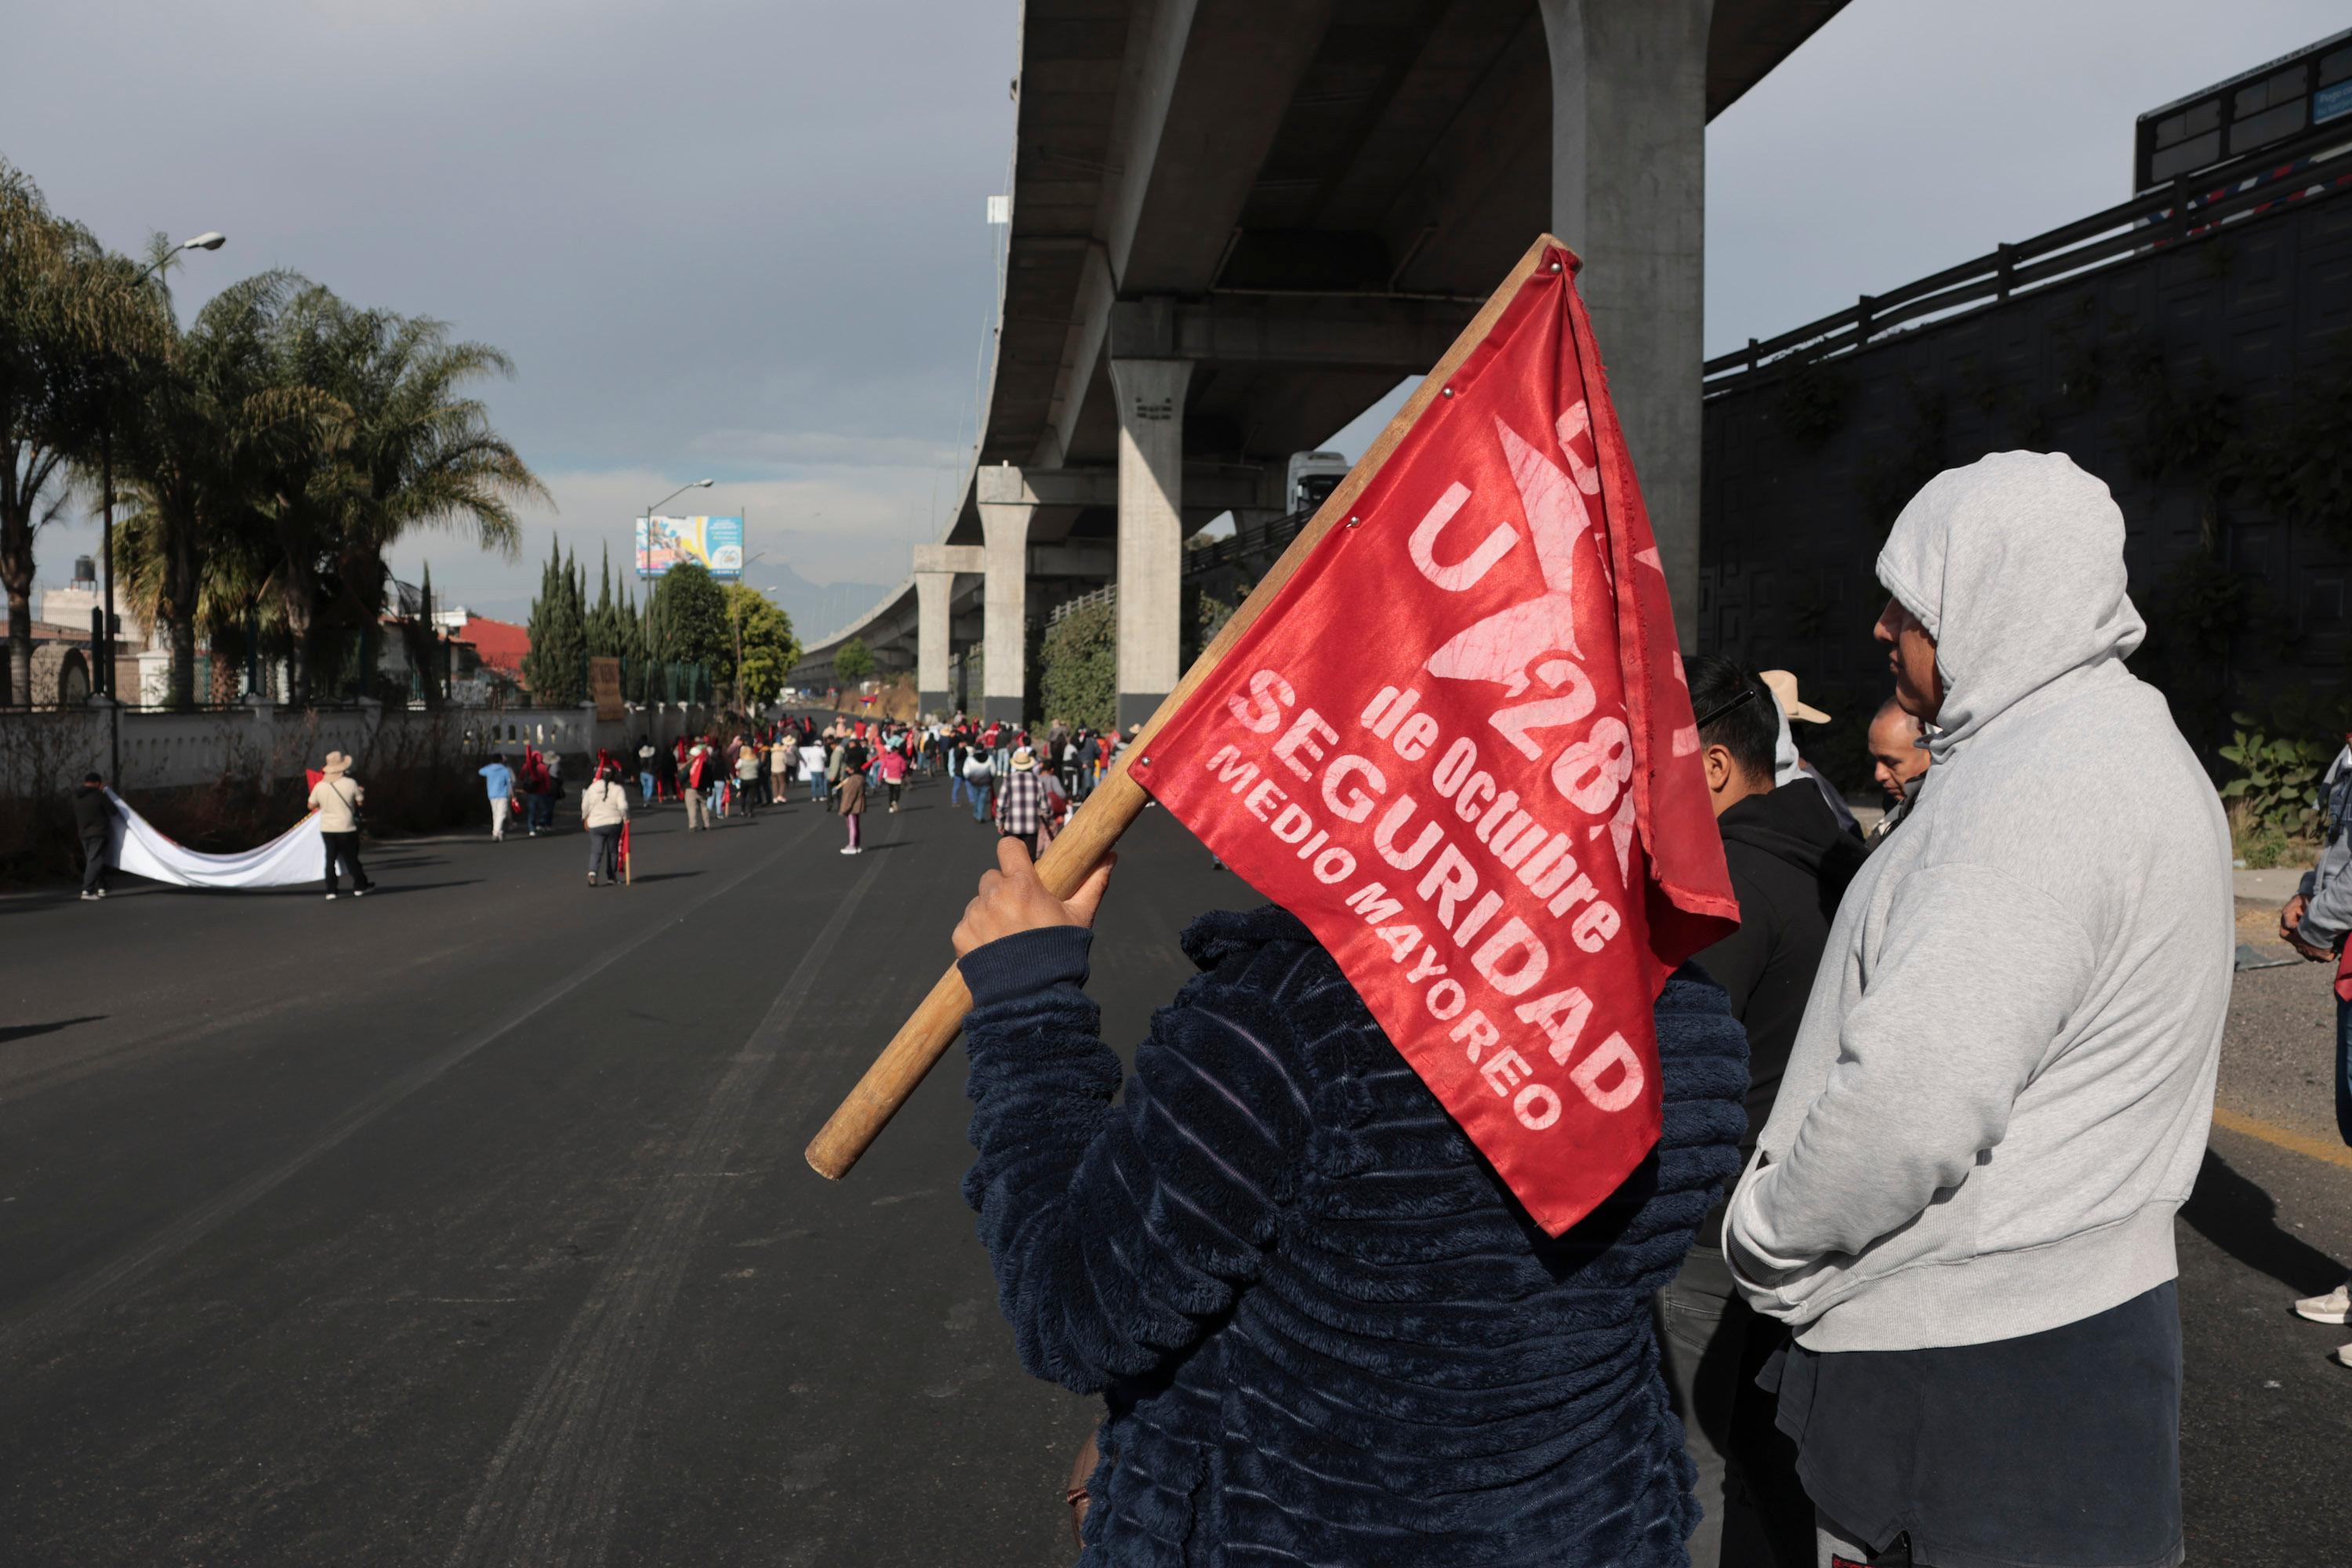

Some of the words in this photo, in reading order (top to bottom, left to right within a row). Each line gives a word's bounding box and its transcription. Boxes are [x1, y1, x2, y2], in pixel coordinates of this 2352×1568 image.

[1408, 481, 1522, 592] U
[1359, 685, 1439, 761] de
[1432, 736, 1621, 953] Octubre
[1488, 657, 1633, 817] 28
[1205, 743, 1357, 884] MEDIO
[1345, 881, 1562, 1131] MAYOREO
[1228, 669, 1645, 1112] SEGURIDAD
